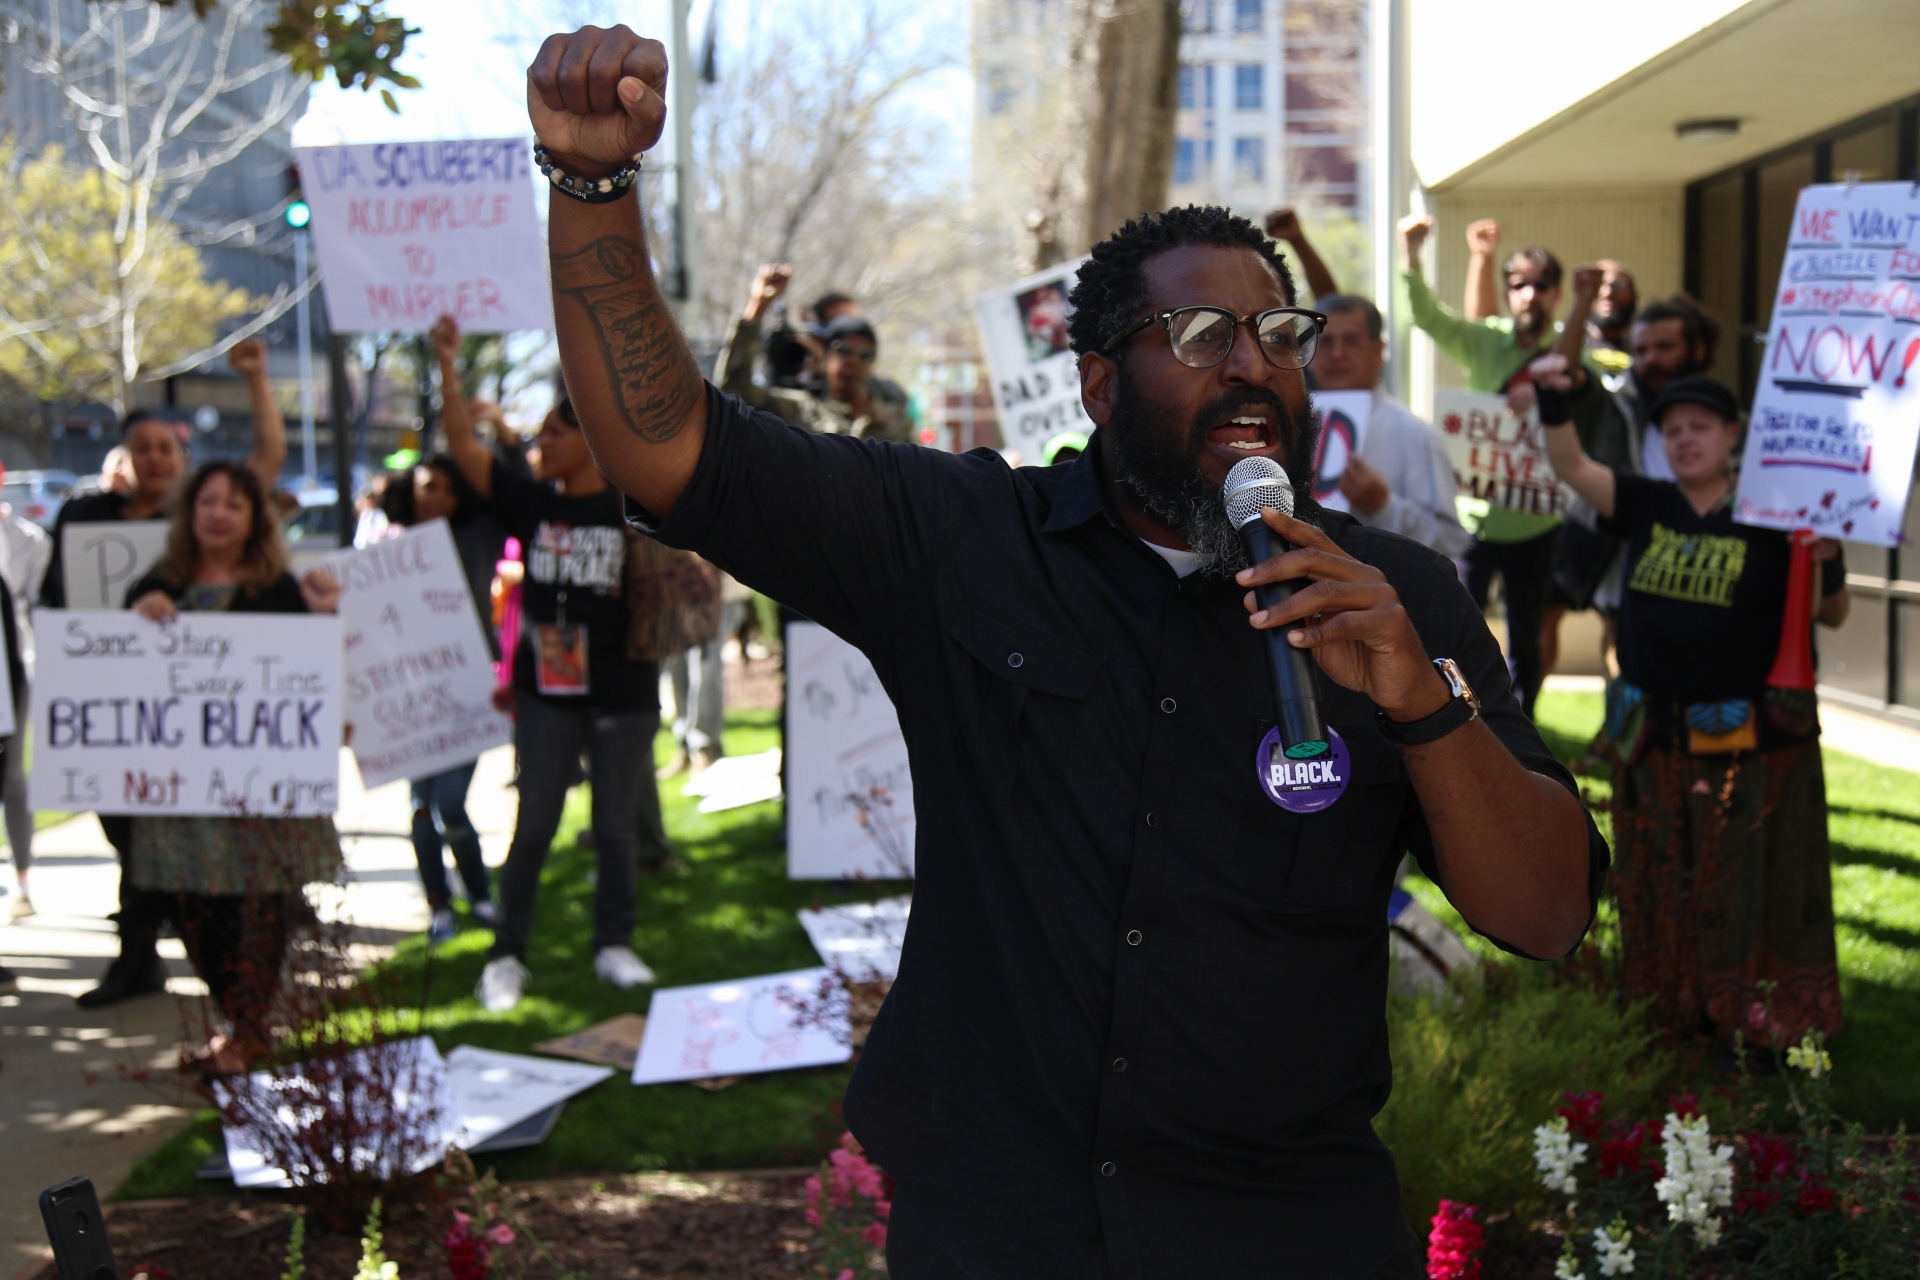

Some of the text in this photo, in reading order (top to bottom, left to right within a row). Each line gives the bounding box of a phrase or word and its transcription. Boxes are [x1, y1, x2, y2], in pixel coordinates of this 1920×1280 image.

[1800, 208, 1920, 242] WE WANT
[402, 244, 437, 278] TO
[1888, 246, 1920, 277] FO
[1771, 324, 1920, 389] NOW!
[322, 532, 441, 592] USTICE
[47, 697, 185, 748] BEING
[201, 698, 323, 748] BLACK
[59, 767, 103, 805] Is
[123, 768, 186, 806] Not
[1270, 760, 1342, 786] BLACK.
